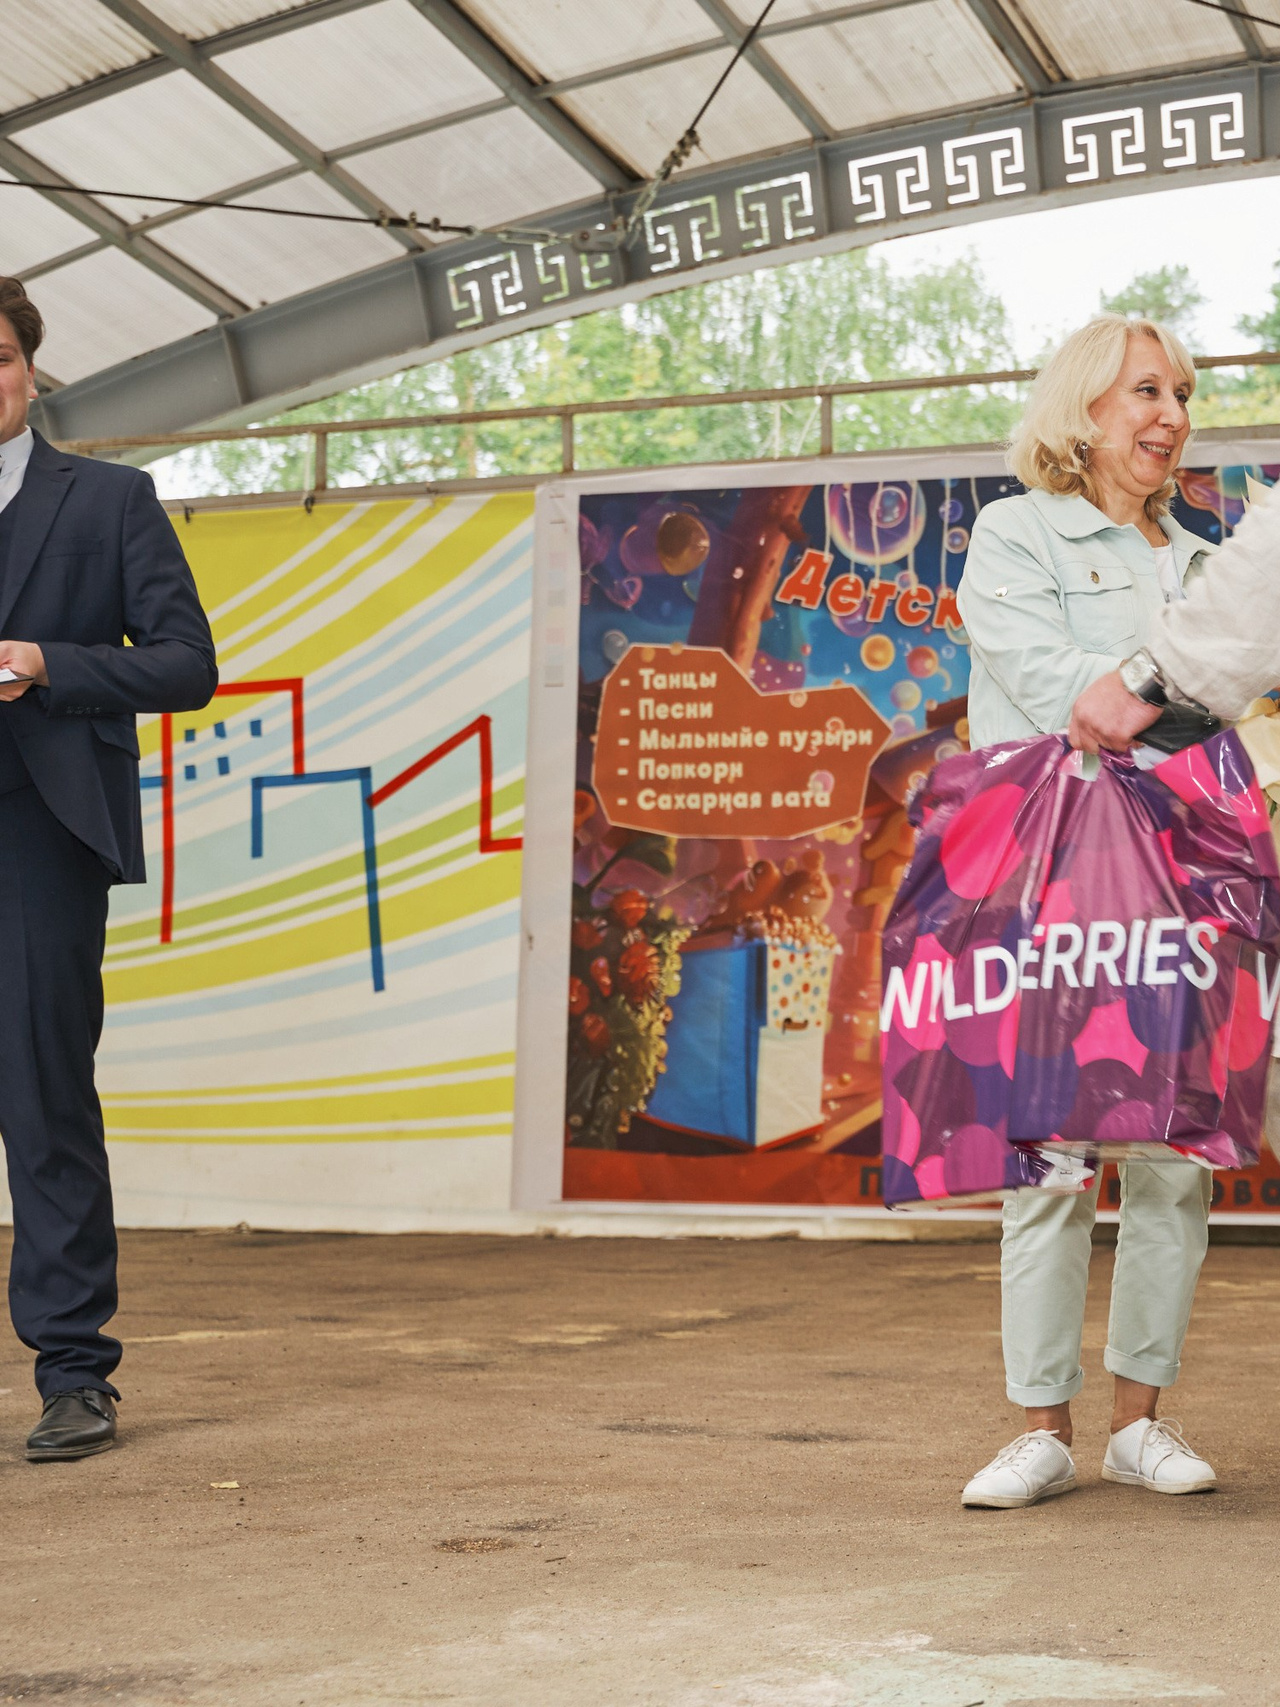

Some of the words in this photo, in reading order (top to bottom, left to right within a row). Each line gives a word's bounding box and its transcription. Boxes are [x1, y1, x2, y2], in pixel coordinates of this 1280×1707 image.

[775, 548, 965, 630] Детск
[638, 668, 717, 691] Танцы
[638, 698, 714, 721] Песни
[638, 727, 769, 751] Мыльныйе
[778, 728, 873, 753] пузыри
[637, 757, 744, 784] Попкорн
[637, 788, 762, 815] Сахарная
[770, 789, 832, 809] вата
